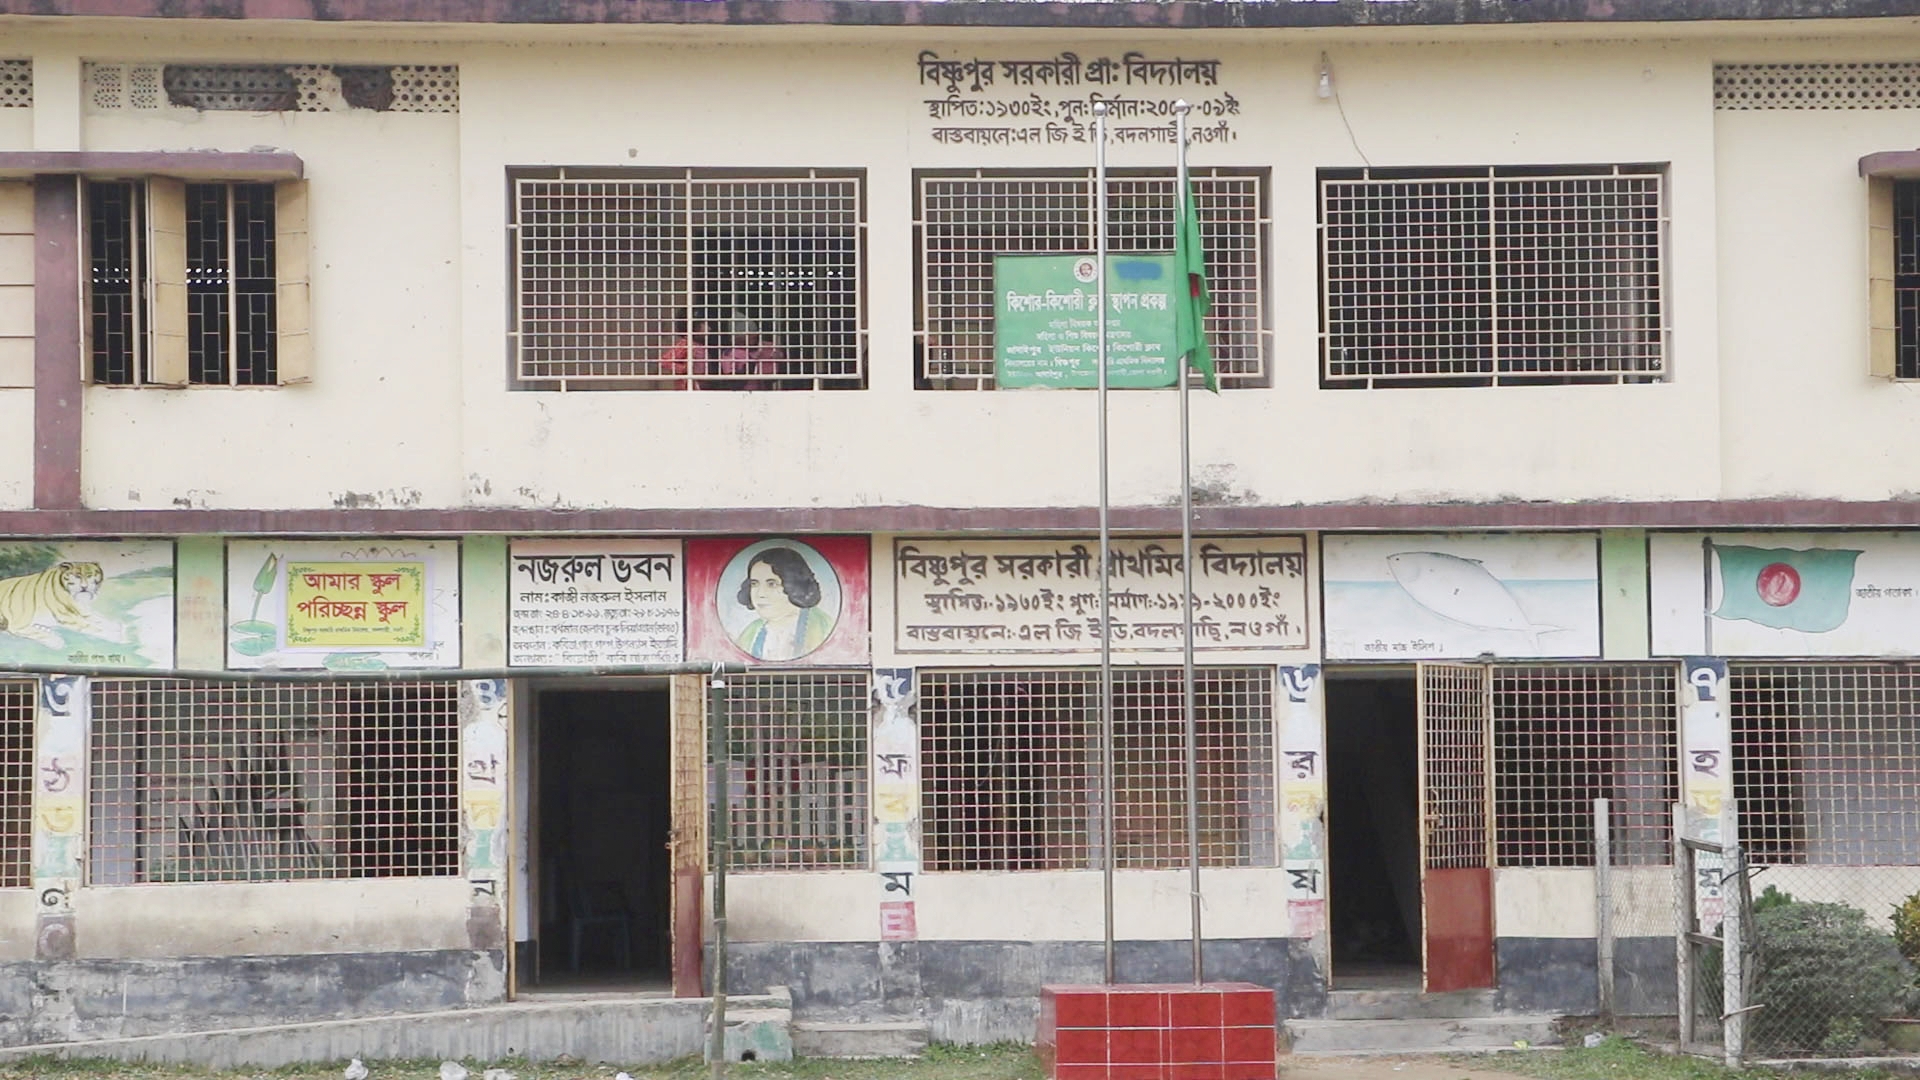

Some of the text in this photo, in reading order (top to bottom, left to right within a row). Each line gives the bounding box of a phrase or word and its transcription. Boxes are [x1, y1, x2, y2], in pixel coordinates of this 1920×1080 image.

[918, 51, 995, 93] বিষ্ণুপুর
[999, 52, 1080, 86] সরকারী
[1122, 51, 1221, 86] বিদ্যালয়
[1046, 122, 1068, 144] জি
[1072, 123, 1086, 143] ই
[1111, 293, 1138, 313] স্থাপন
[1141, 293, 1168, 311] প্রকল্প
[513, 553, 676, 584] নজরুল ভবন
[899, 546, 987, 586] বিষ্ণুপুর
[994, 546, 1092, 579] সরকারী
[1200, 545, 1302, 579] বিদ্যালয়
[303, 573, 401, 596] আমার স্কুল
[551, 587, 578, 603] কাজী
[624, 587, 667, 604] ইসলাম
[297, 596, 408, 623] পরিচ্ছন্ন স্কুল
[1284, 751, 1320, 778] র
[881, 872, 914, 895] ম
